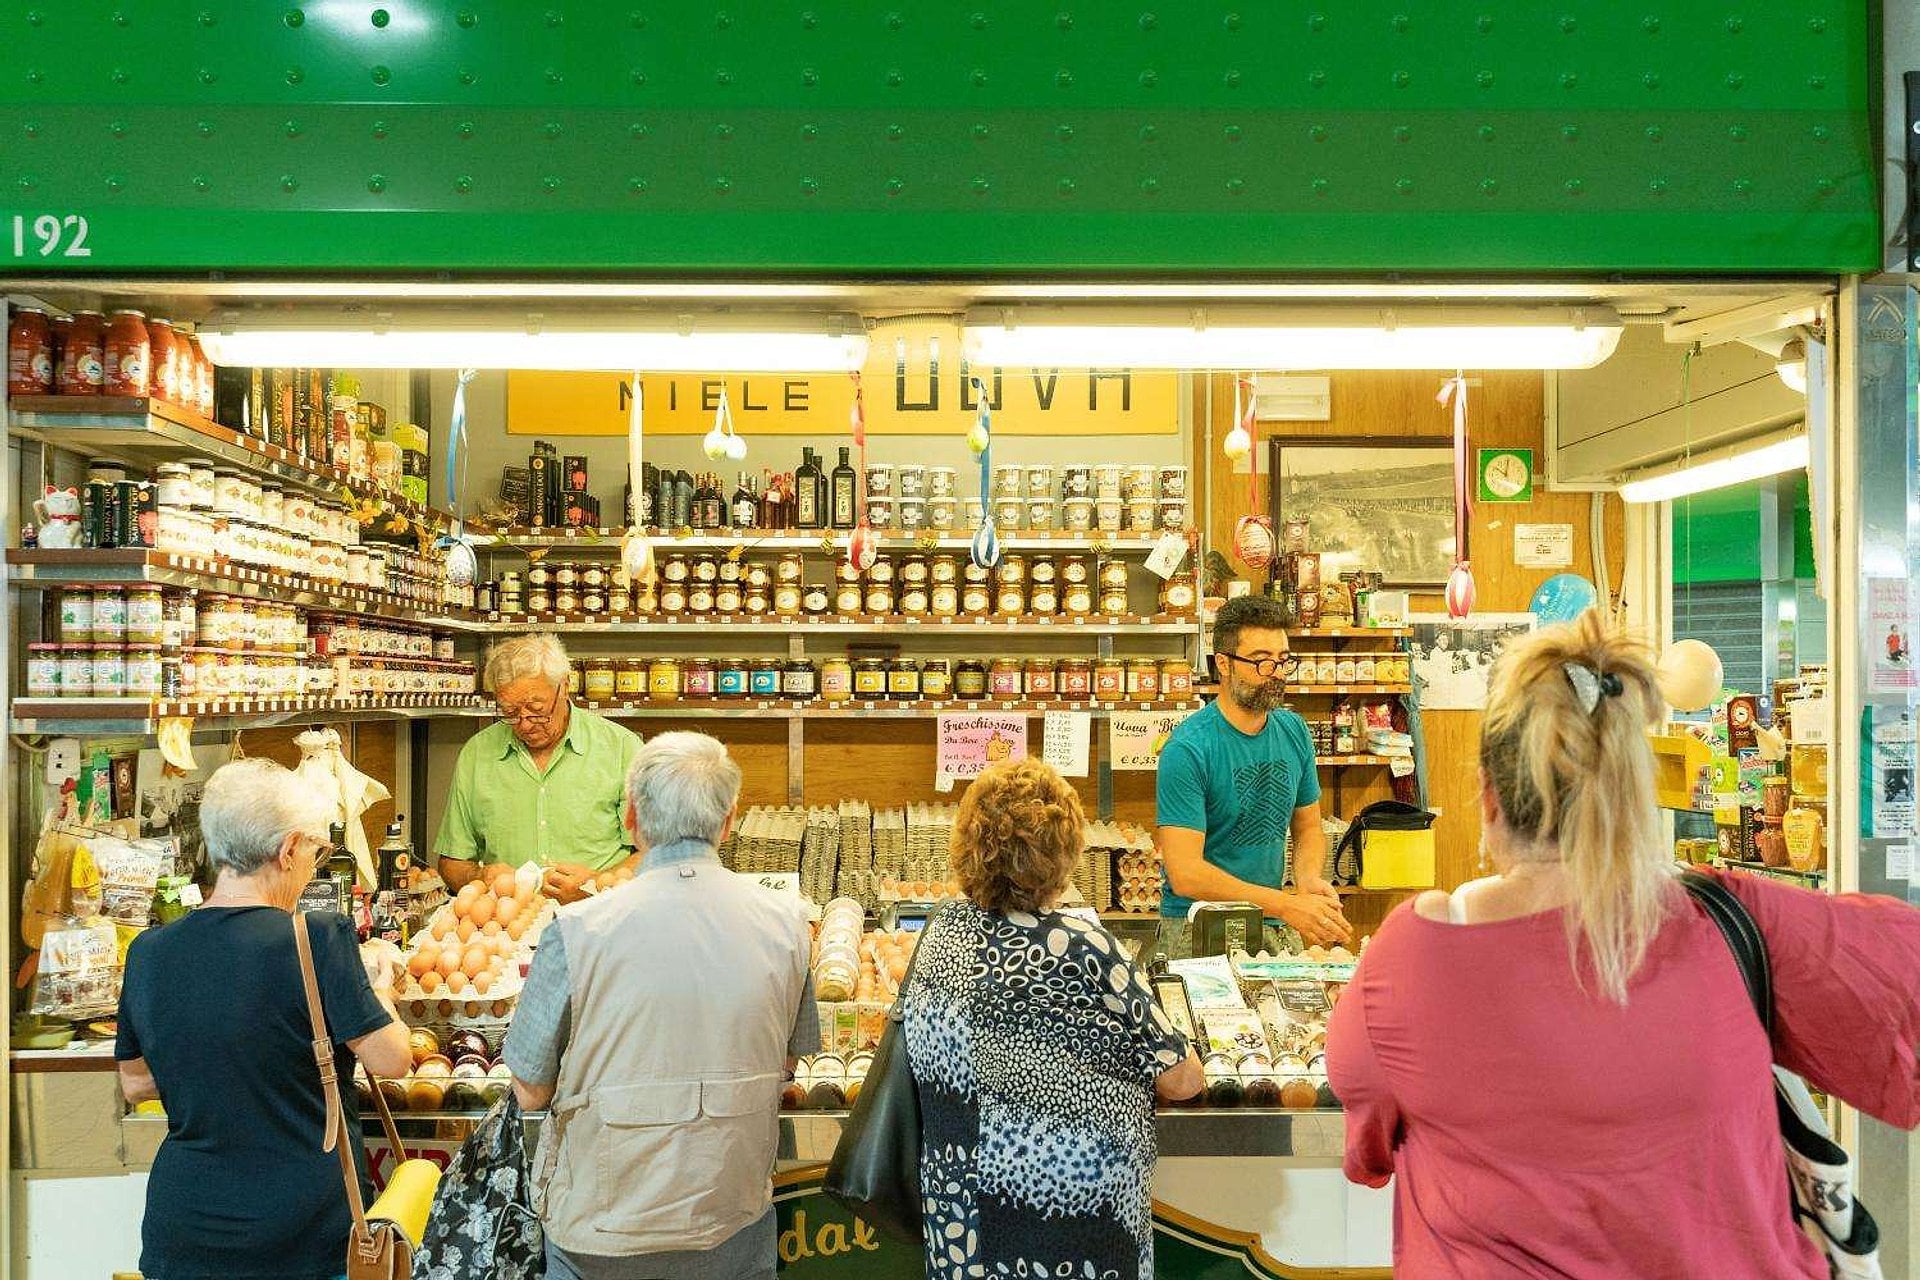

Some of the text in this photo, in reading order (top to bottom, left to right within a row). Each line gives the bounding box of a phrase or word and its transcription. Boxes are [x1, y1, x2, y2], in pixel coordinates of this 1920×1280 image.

[12, 214, 92, 257] 192
[943, 716, 1023, 734] Freschissime
[1113, 721, 1148, 733] Uova
